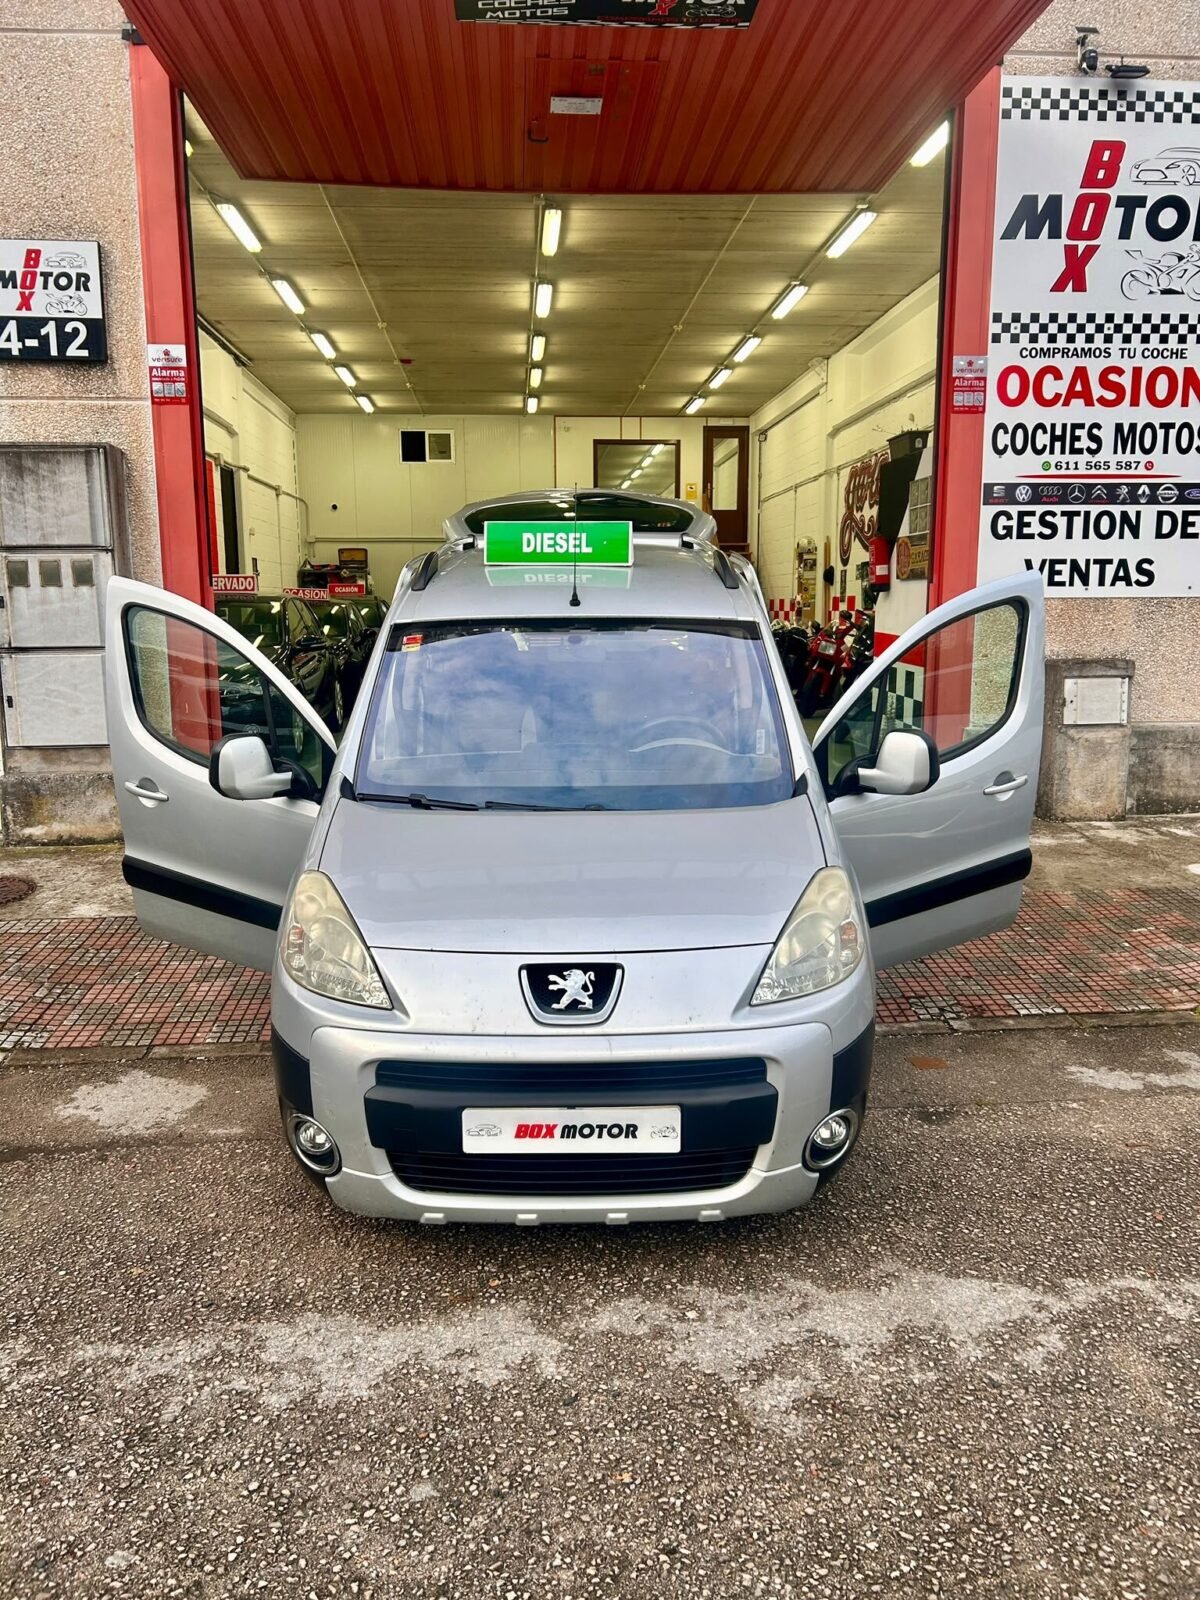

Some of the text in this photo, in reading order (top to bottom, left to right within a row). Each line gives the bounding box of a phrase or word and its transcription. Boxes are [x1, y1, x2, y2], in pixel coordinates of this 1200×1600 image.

[486, 7, 569, 18] MOTOS
[1000, 193, 1200, 242] MOTO
[1050, 140, 1126, 292] BOX
[16, 248, 41, 311] BOX
[1019, 346, 1188, 360] COMPRAMOS TU COCHE
[152, 368, 185, 377] Alarma
[954, 378, 985, 387] Alarma
[991, 421, 1103, 456] COCHES
[1054, 461, 1141, 471] 611 565 587
[990, 510, 1200, 540] GESTION DE
[522, 532, 593, 553] DIESEL
[514, 1123, 638, 1139] BOX MOTOR
